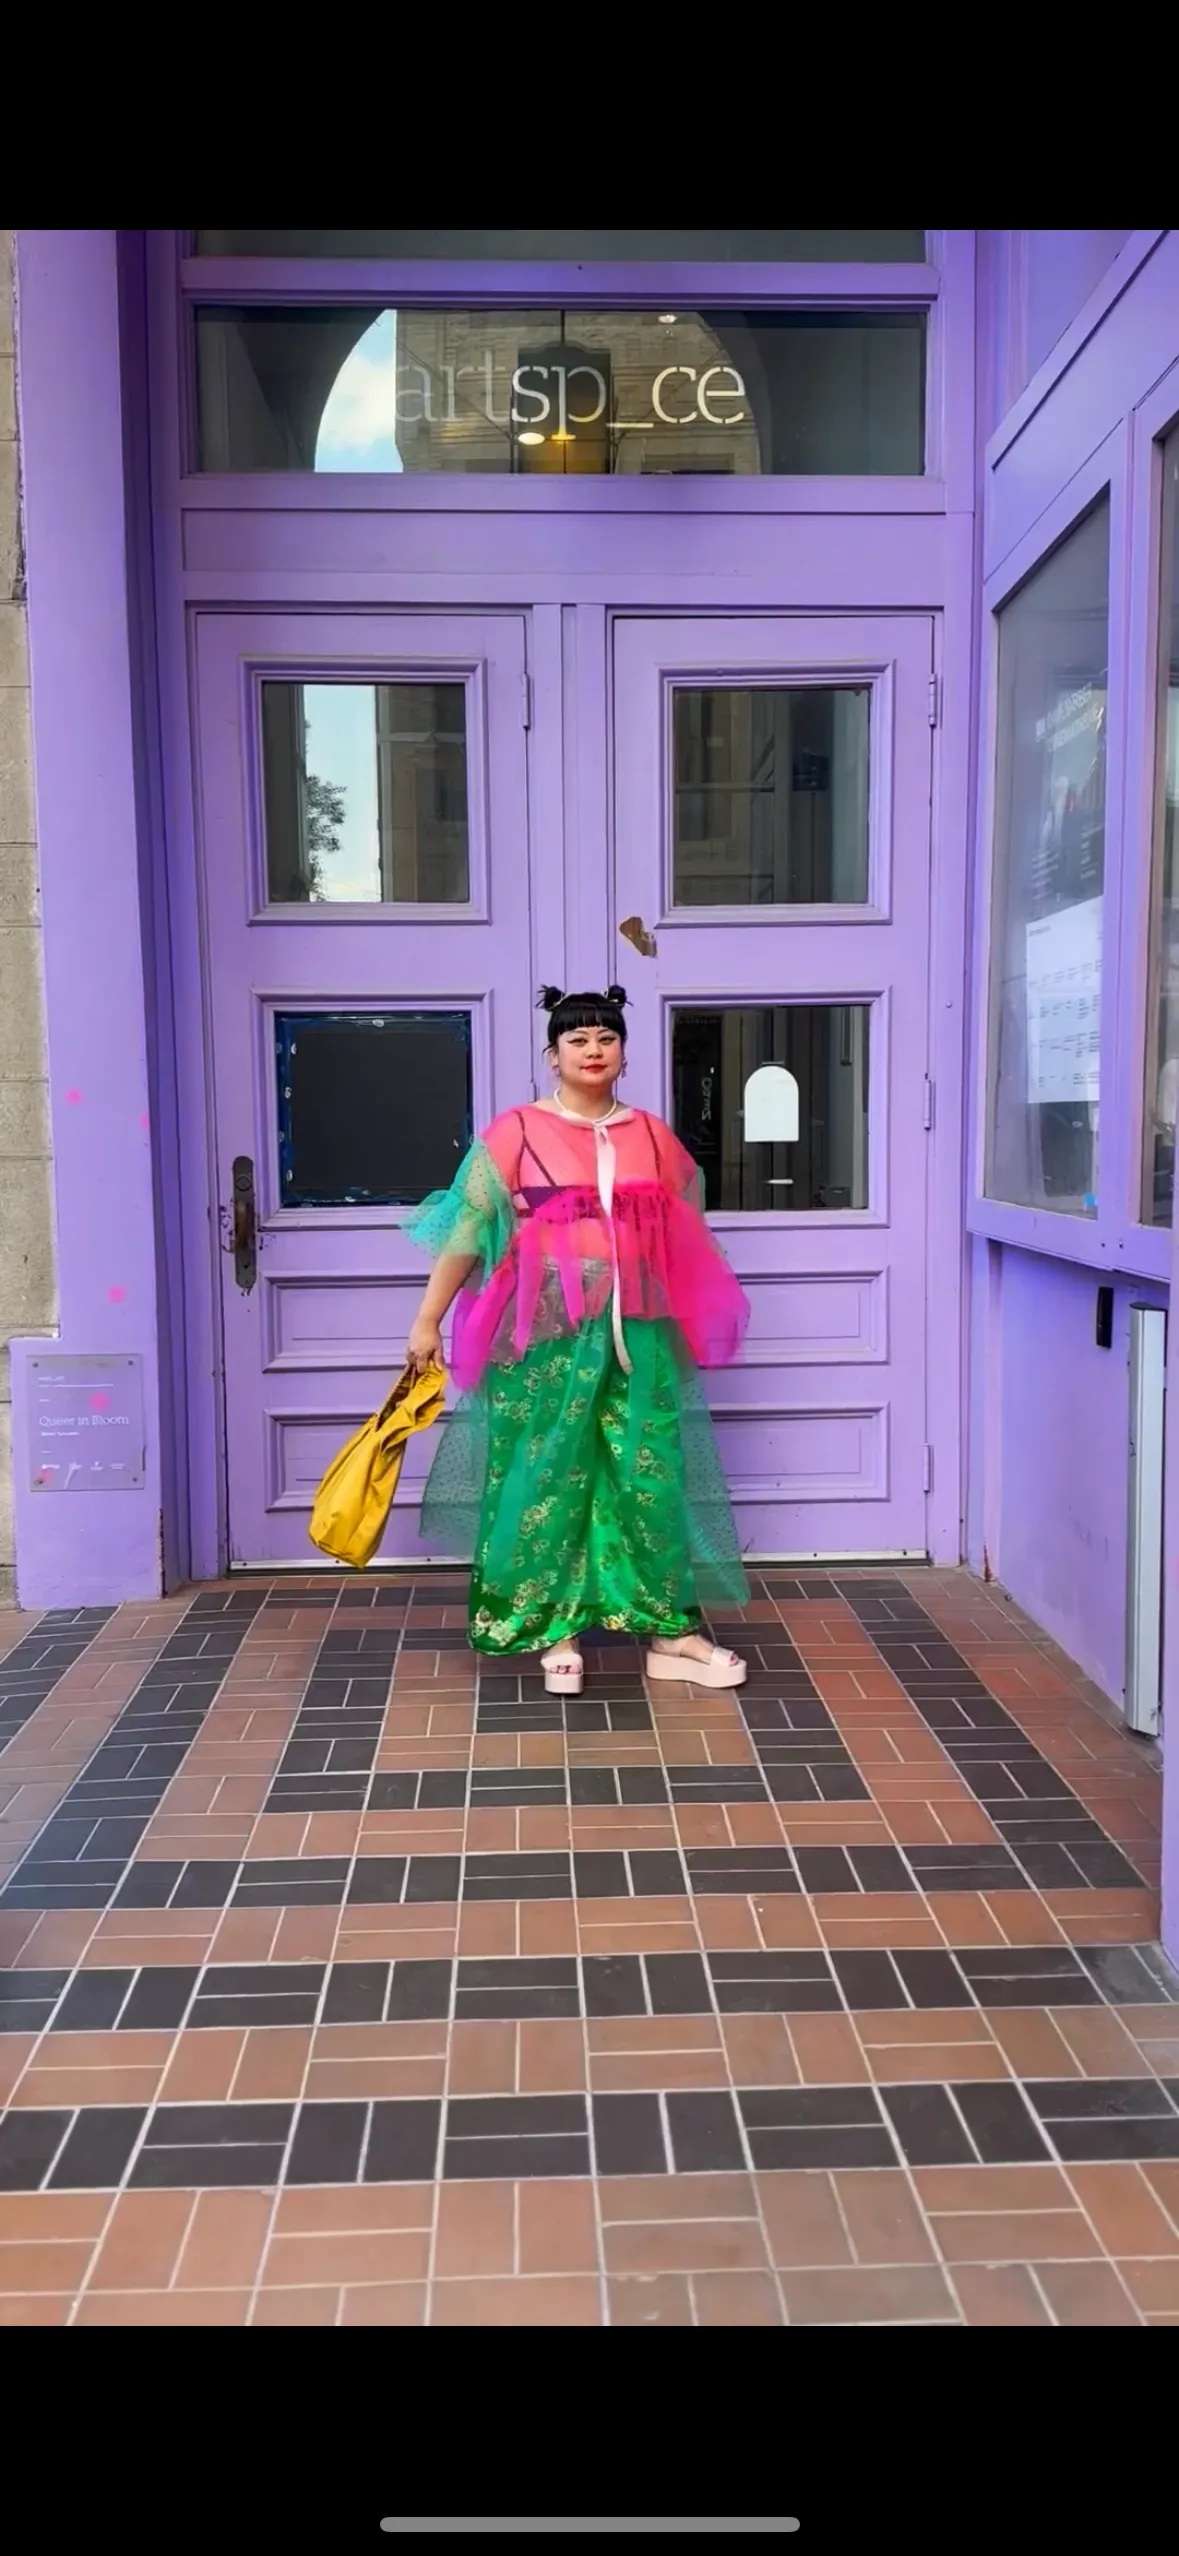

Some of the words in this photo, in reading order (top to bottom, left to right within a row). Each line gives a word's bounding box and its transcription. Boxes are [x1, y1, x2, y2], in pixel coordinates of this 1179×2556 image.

[394, 350, 746, 440] artsp_ce
[39, 1415, 75, 1427] Queer
[77, 1415, 89, 1426] in
[91, 1414, 129, 1426] Bloom
